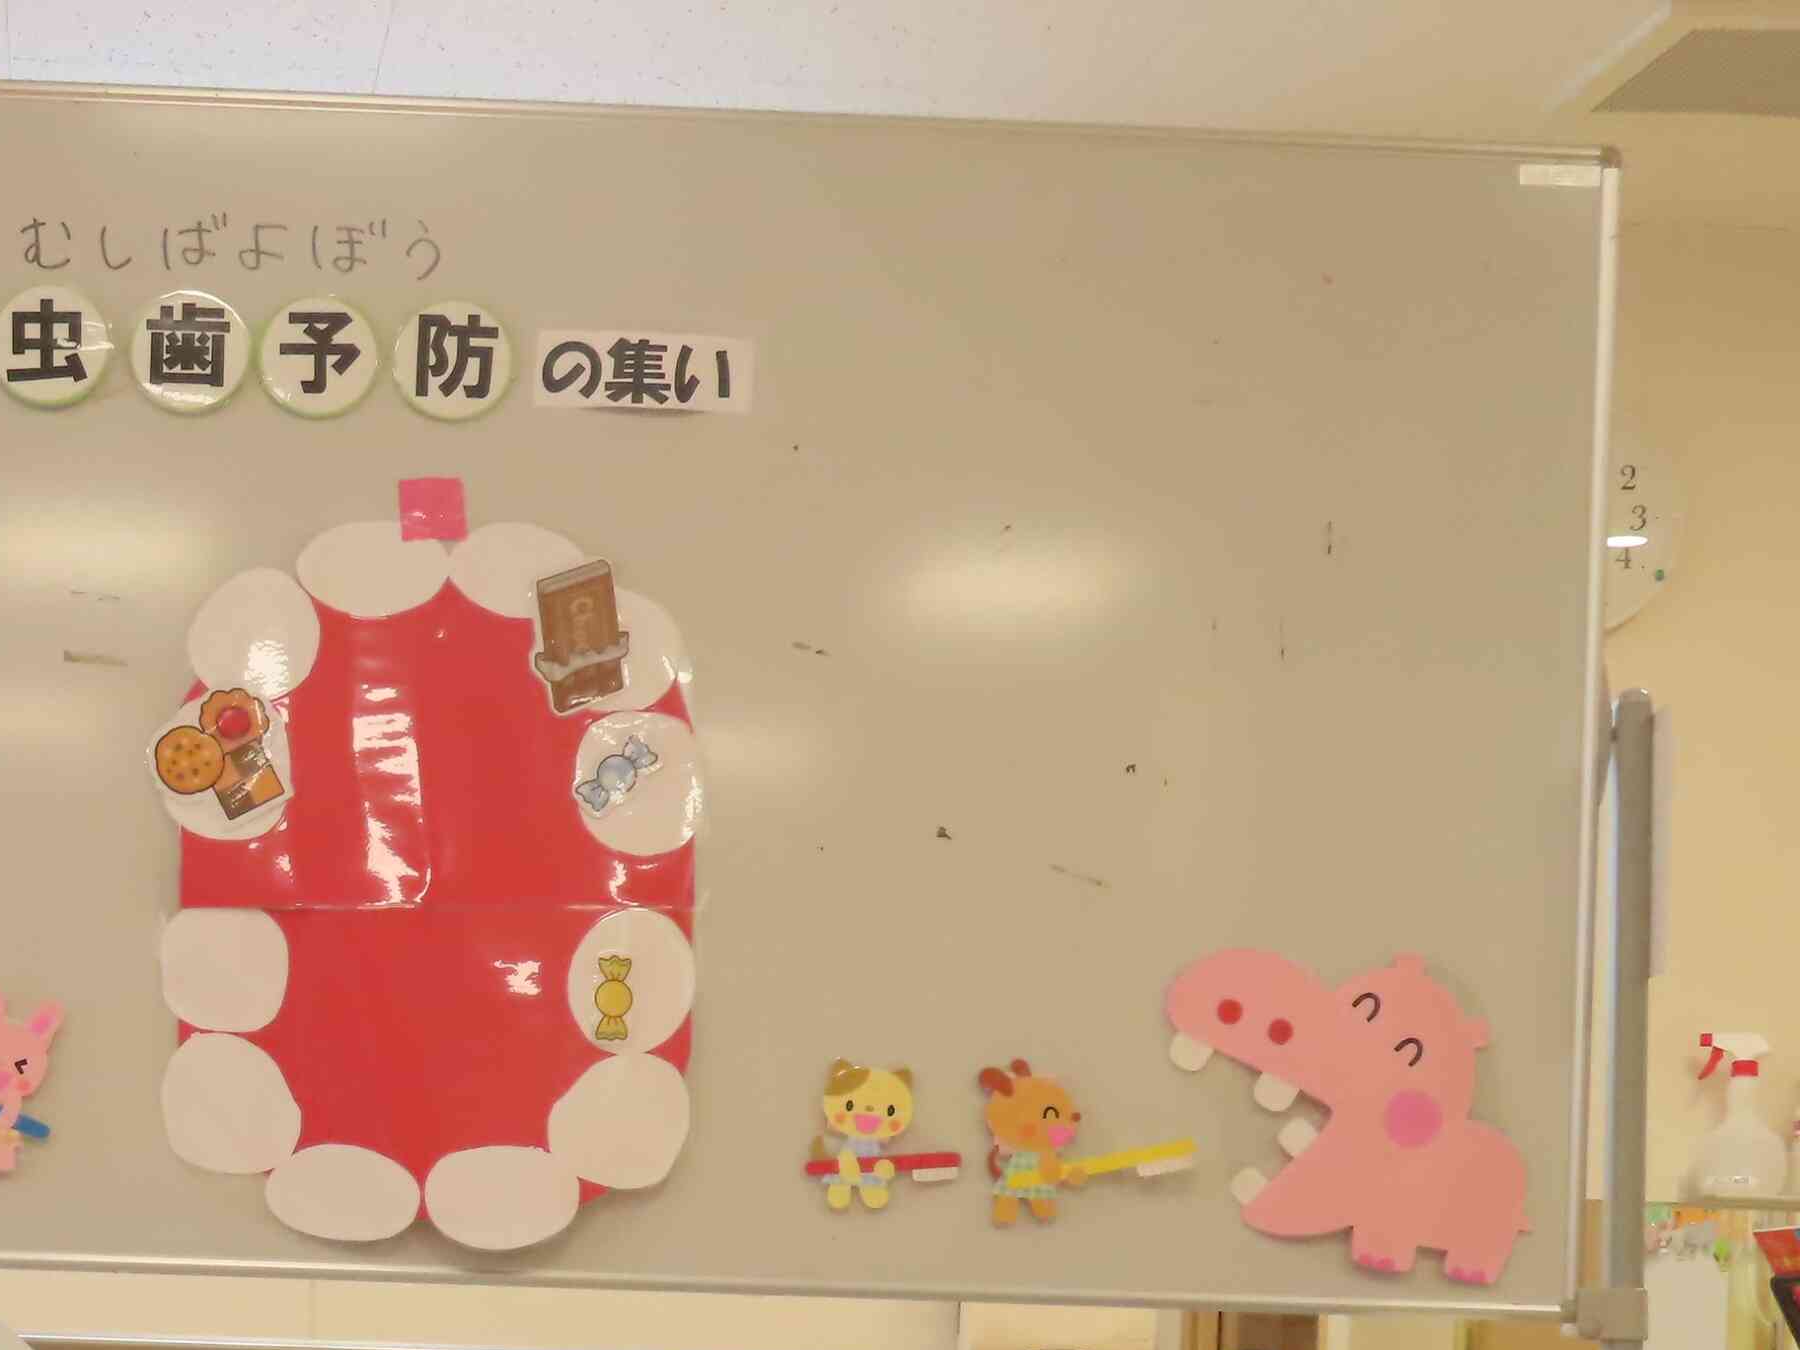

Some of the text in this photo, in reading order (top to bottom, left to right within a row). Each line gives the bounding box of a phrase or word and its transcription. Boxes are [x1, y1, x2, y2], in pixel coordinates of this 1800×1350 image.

[20, 211, 443, 281] むしばよぼう
[1620, 465, 1637, 491] 2
[1630, 505, 1648, 531] 3
